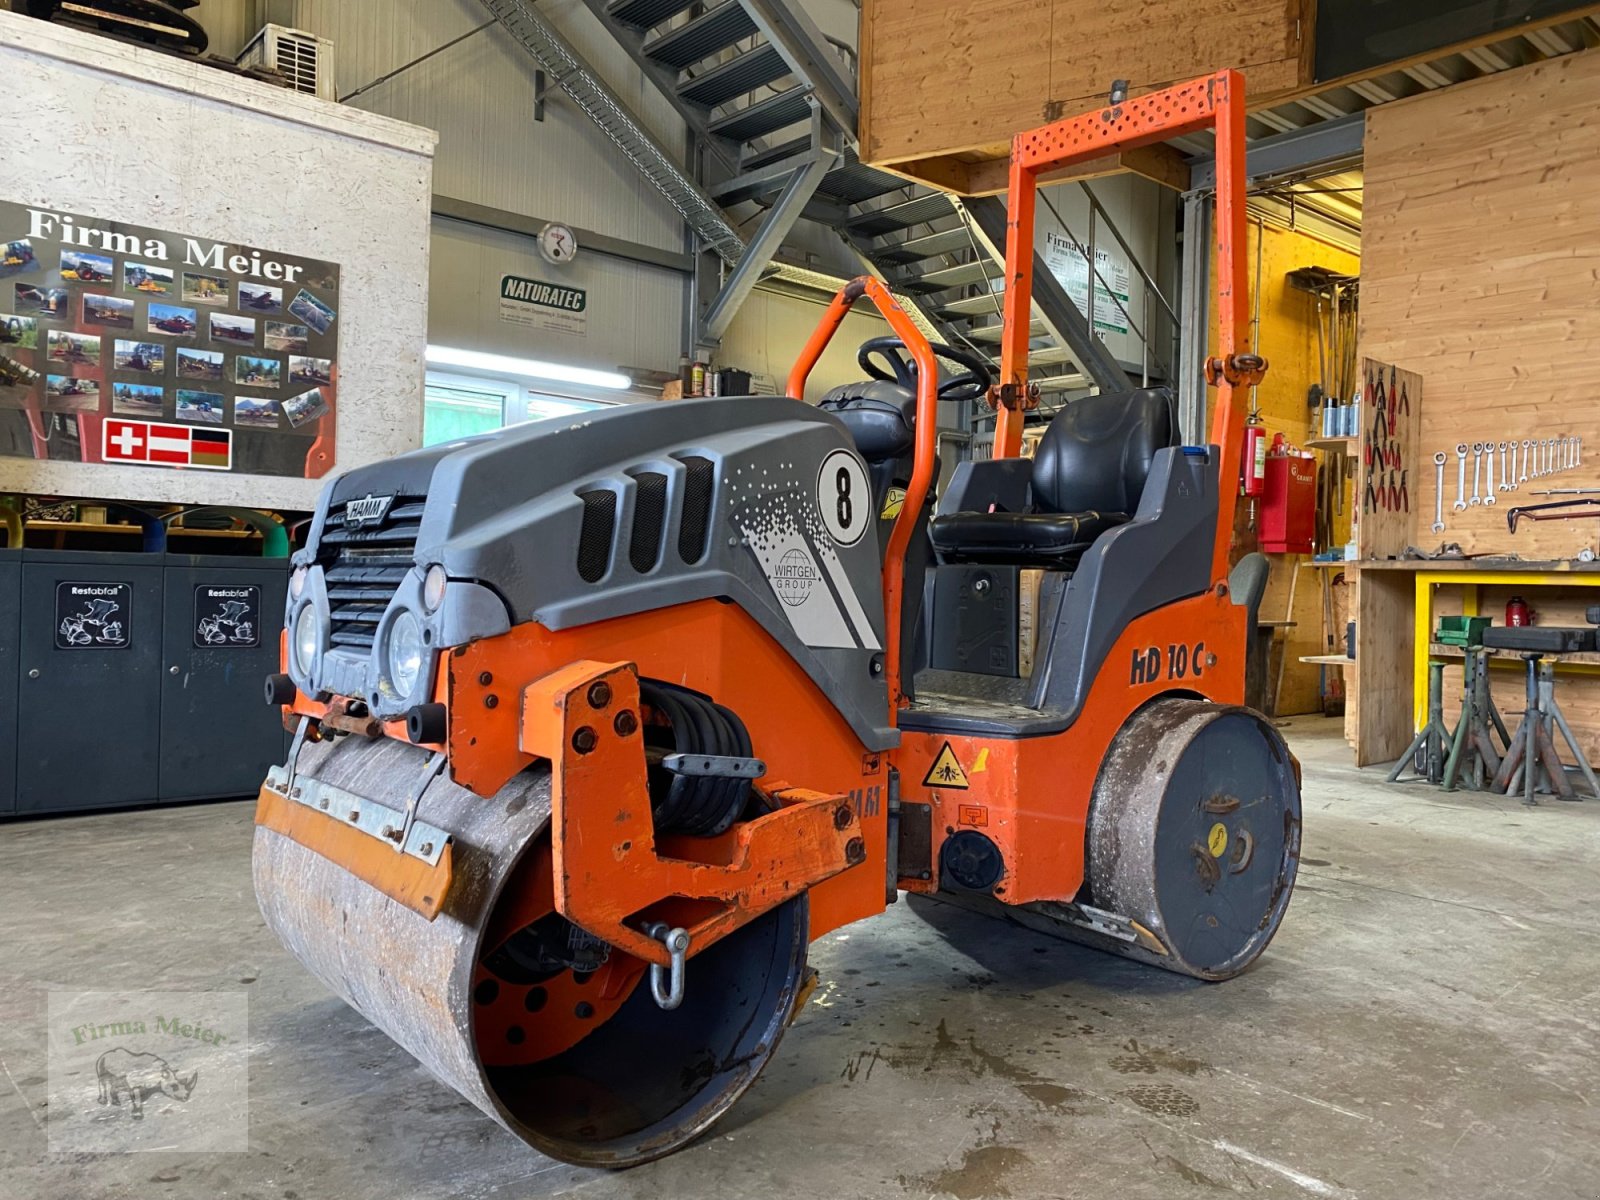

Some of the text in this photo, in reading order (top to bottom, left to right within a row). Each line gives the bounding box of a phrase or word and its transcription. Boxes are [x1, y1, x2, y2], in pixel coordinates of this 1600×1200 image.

[26, 209, 303, 284] Firma Meier
[1047, 232, 1077, 251] Firma
[504, 278, 582, 310] NATURATEC
[837, 467, 852, 529] 8
[350, 500, 382, 518] HAMM
[775, 565, 816, 578] WIRTGEN
[71, 586, 118, 596] Restabfall
[208, 589, 249, 597] Restabfall
[777, 580, 813, 589] GROUP
[1130, 642, 1204, 685] HD 10 C
